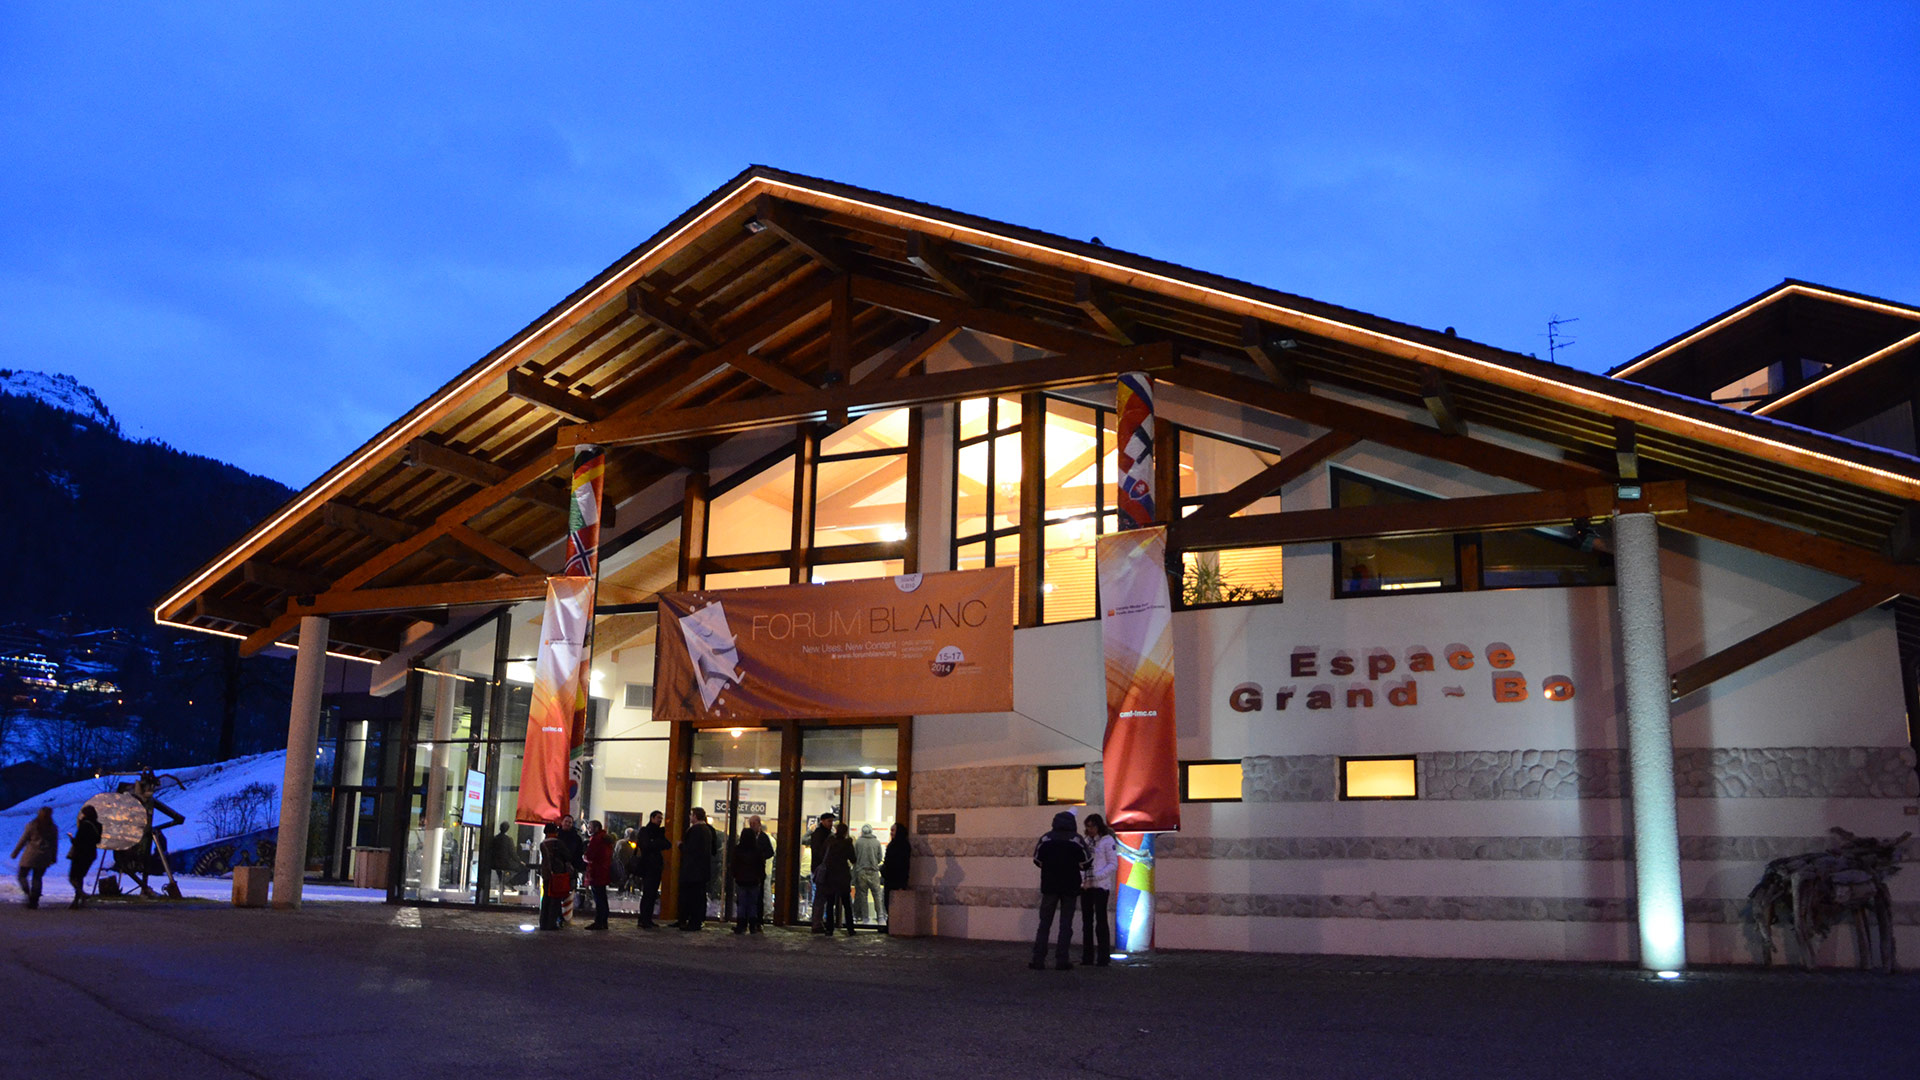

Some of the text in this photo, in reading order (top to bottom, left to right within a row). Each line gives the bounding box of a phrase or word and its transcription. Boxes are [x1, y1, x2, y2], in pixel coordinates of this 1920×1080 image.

[752, 609, 862, 641] FORUM
[802, 645, 820, 654] New
[845, 641, 863, 651] New
[865, 640, 897, 650] Content
[938, 651, 962, 661] 15-17
[931, 663, 951, 673] 2014
[1290, 648, 1516, 680] Espace
[1229, 680, 1418, 713] Grand
[751, 803, 765, 812] 600
